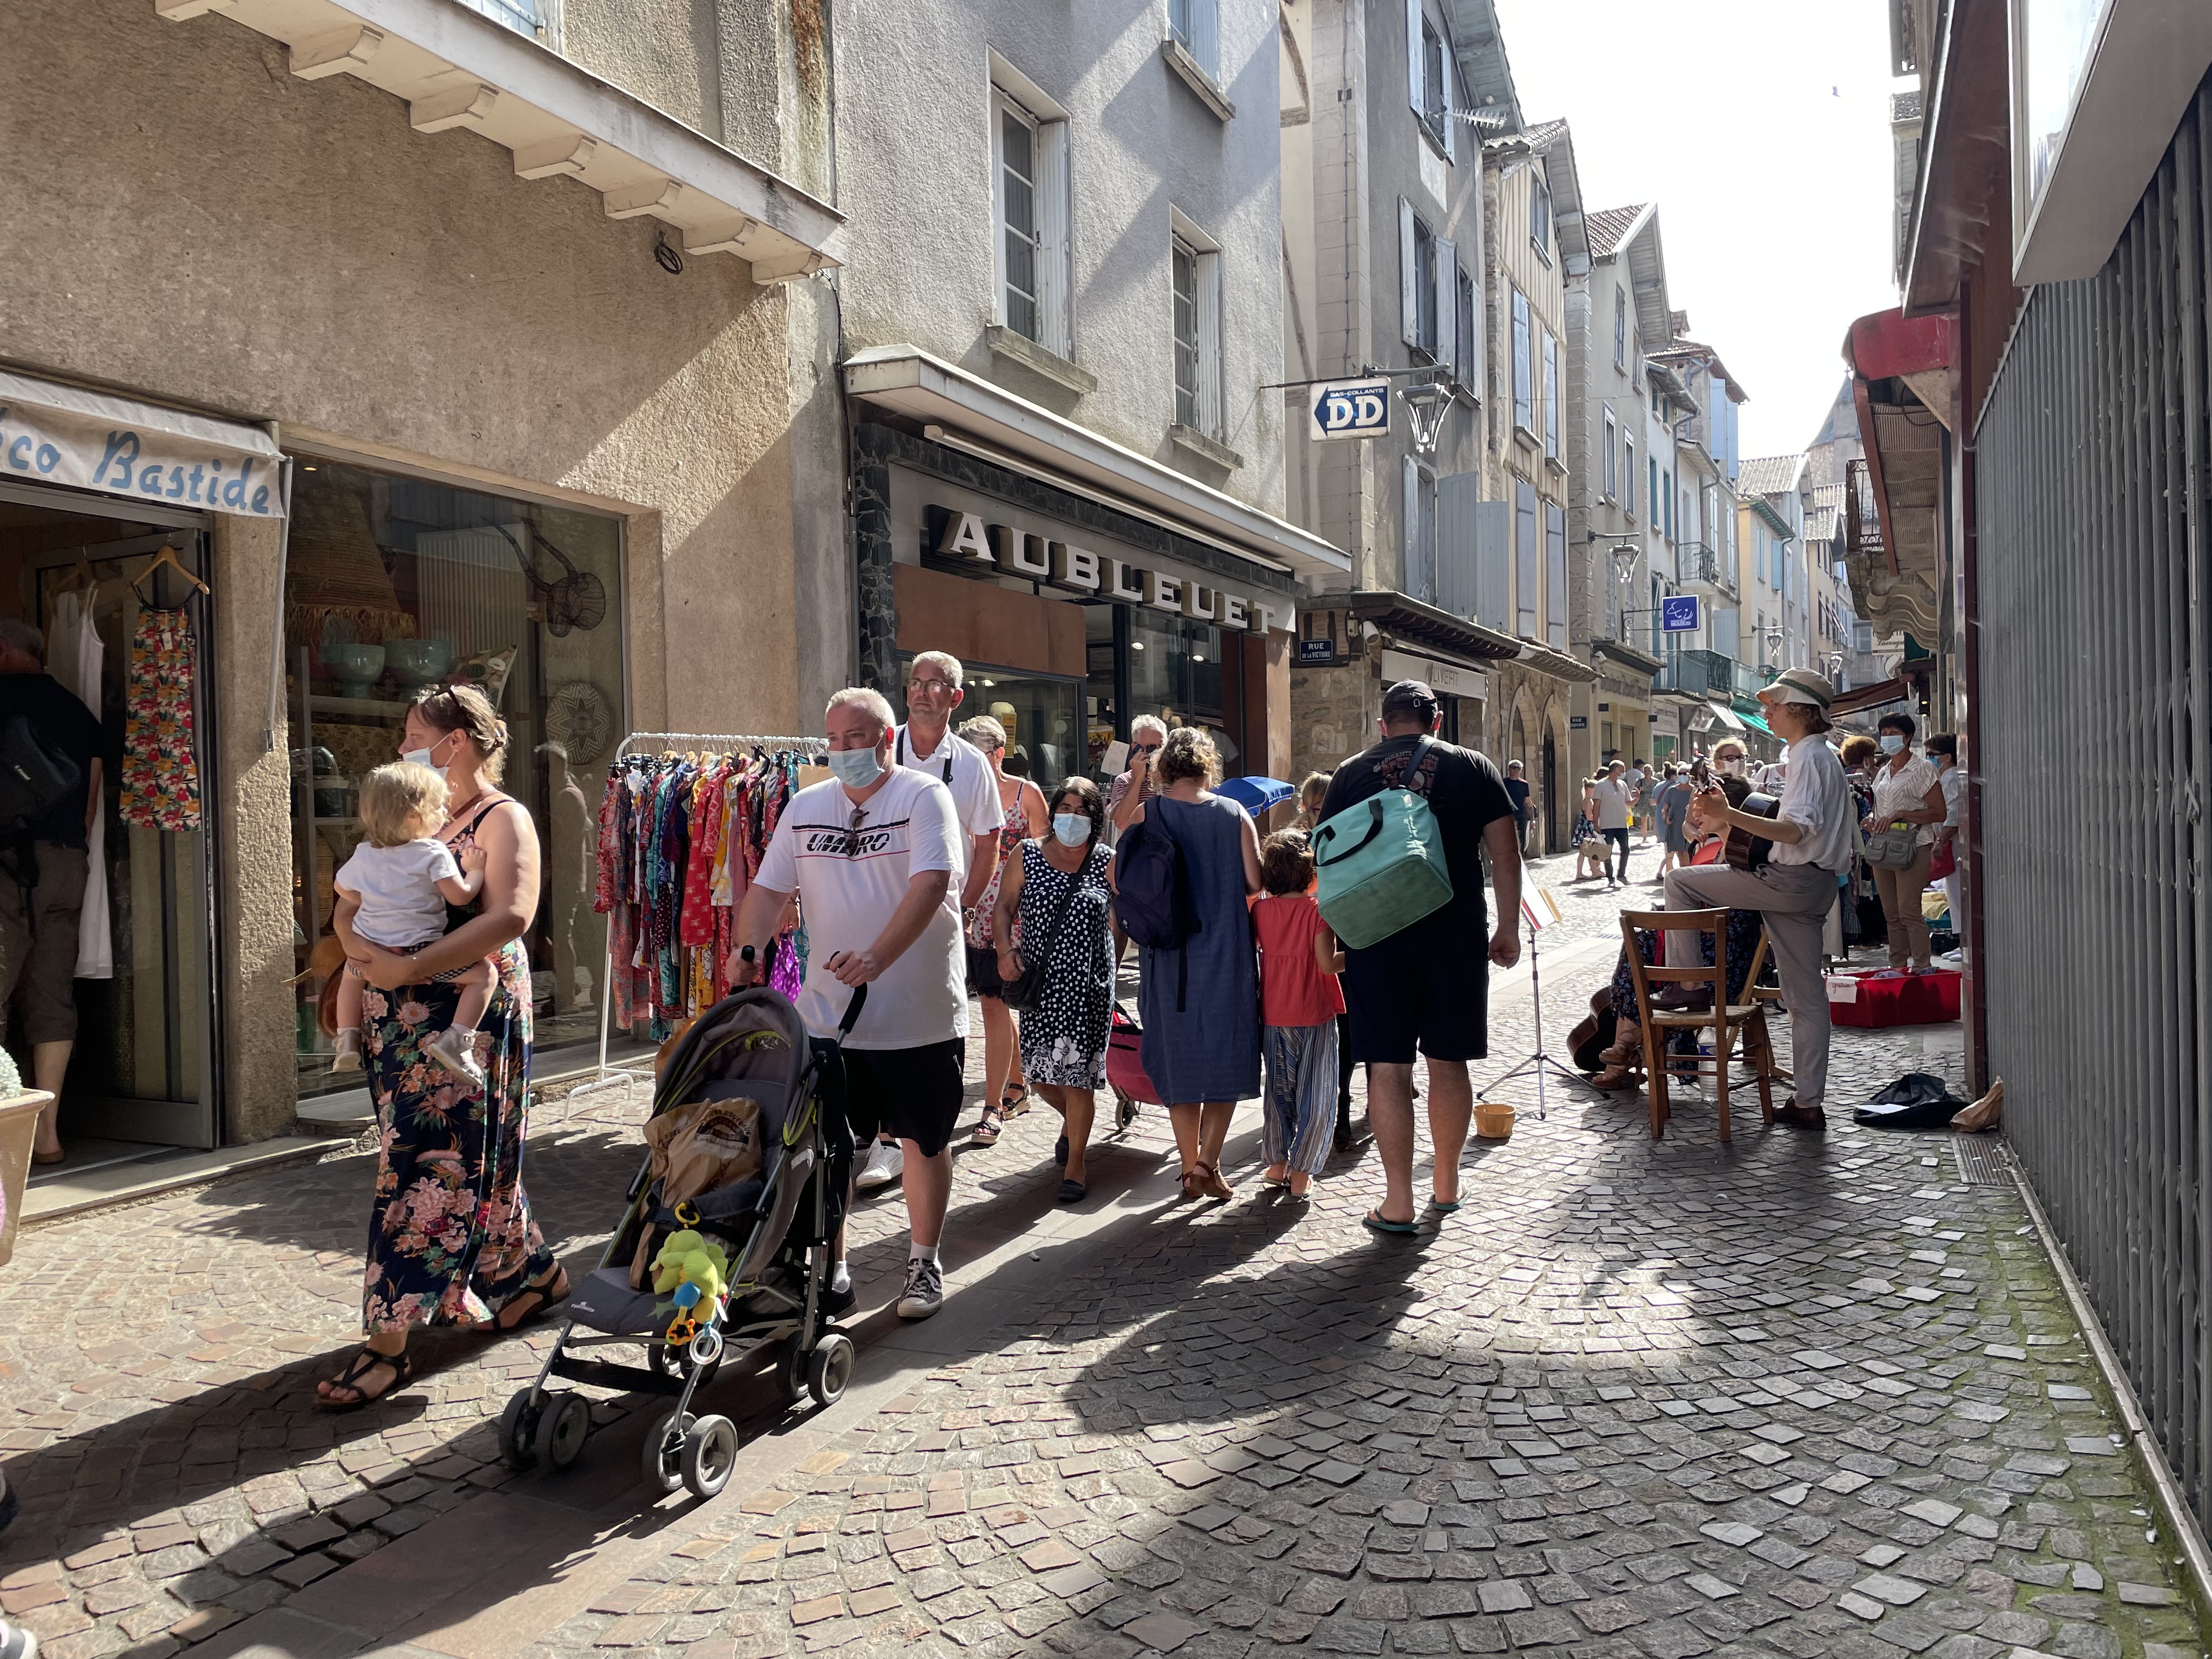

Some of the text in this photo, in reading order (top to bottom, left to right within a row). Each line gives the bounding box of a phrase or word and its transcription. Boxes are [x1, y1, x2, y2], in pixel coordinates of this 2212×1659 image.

[1327, 395, 1384, 428] DD
[93, 431, 269, 514] Bastide
[938, 511, 1275, 635] AUBLEUET
